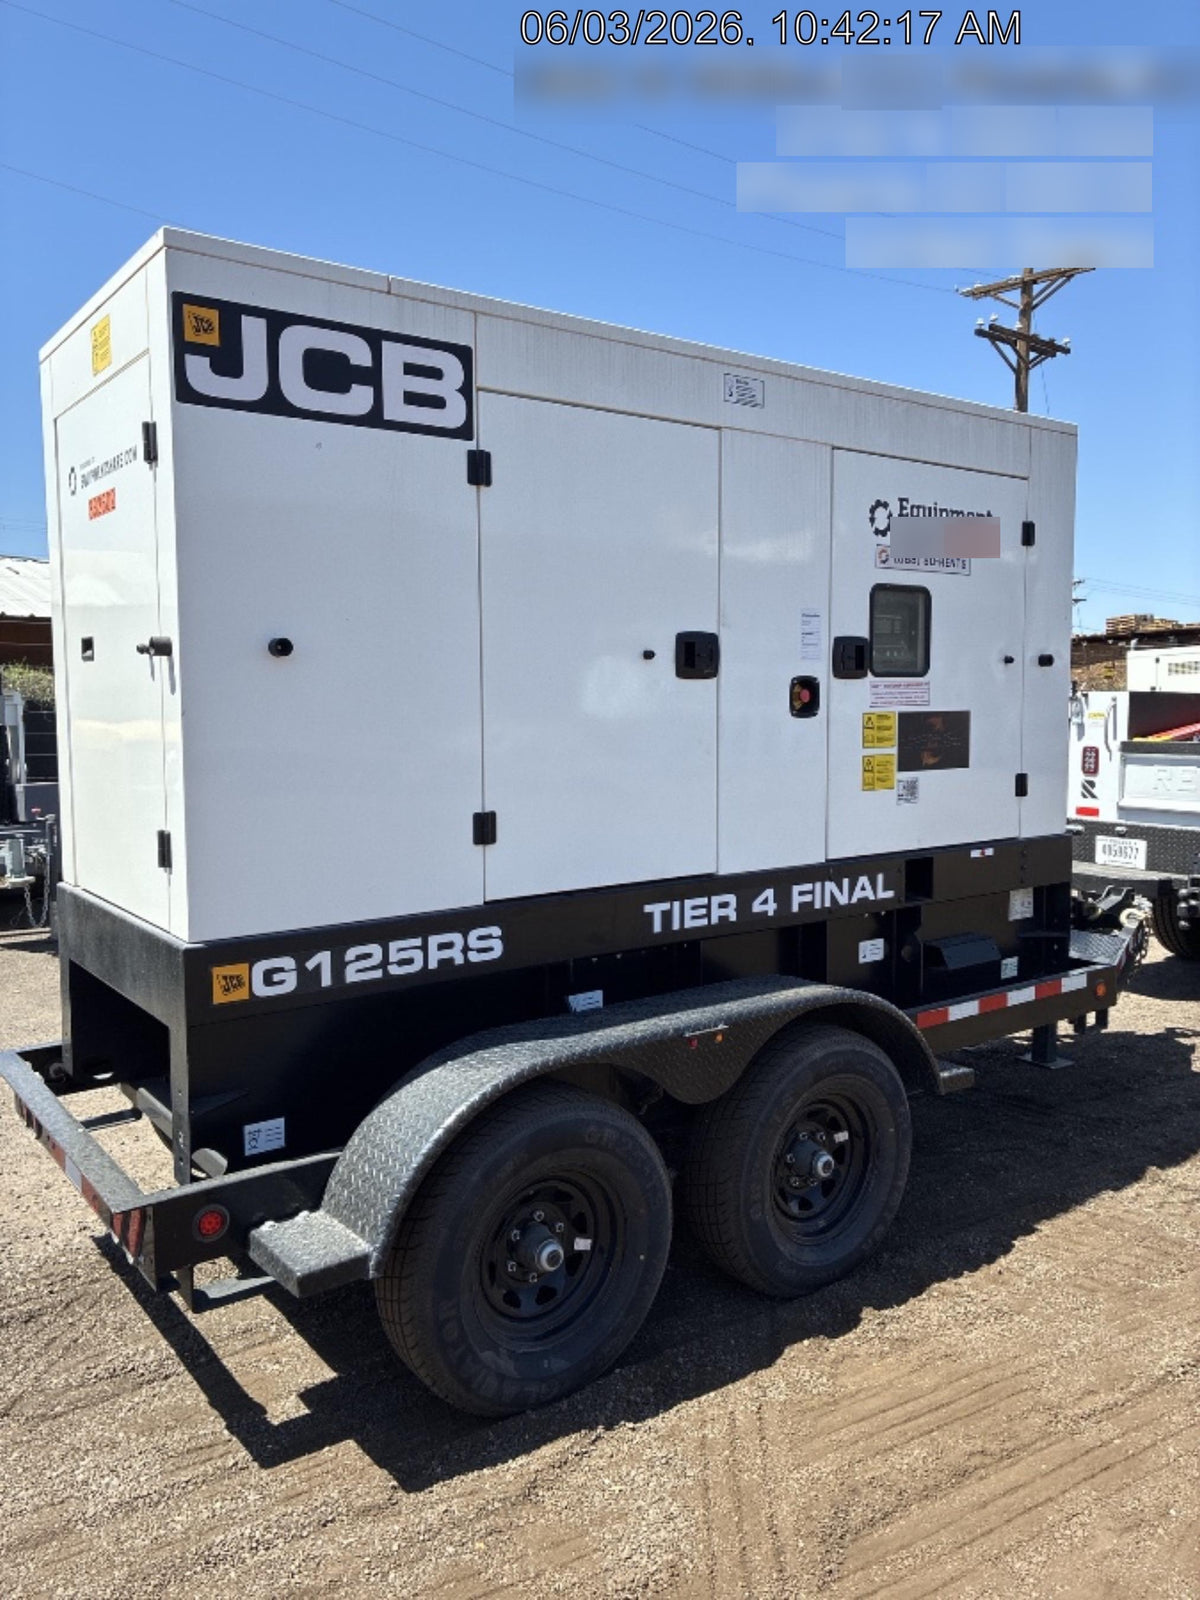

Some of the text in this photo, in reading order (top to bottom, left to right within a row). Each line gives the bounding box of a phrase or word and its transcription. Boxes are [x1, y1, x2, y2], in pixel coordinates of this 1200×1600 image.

[184, 314, 468, 430] JCB
[643, 873, 895, 933] TIER 4 FINAL
[251, 925, 504, 998] G125RS
